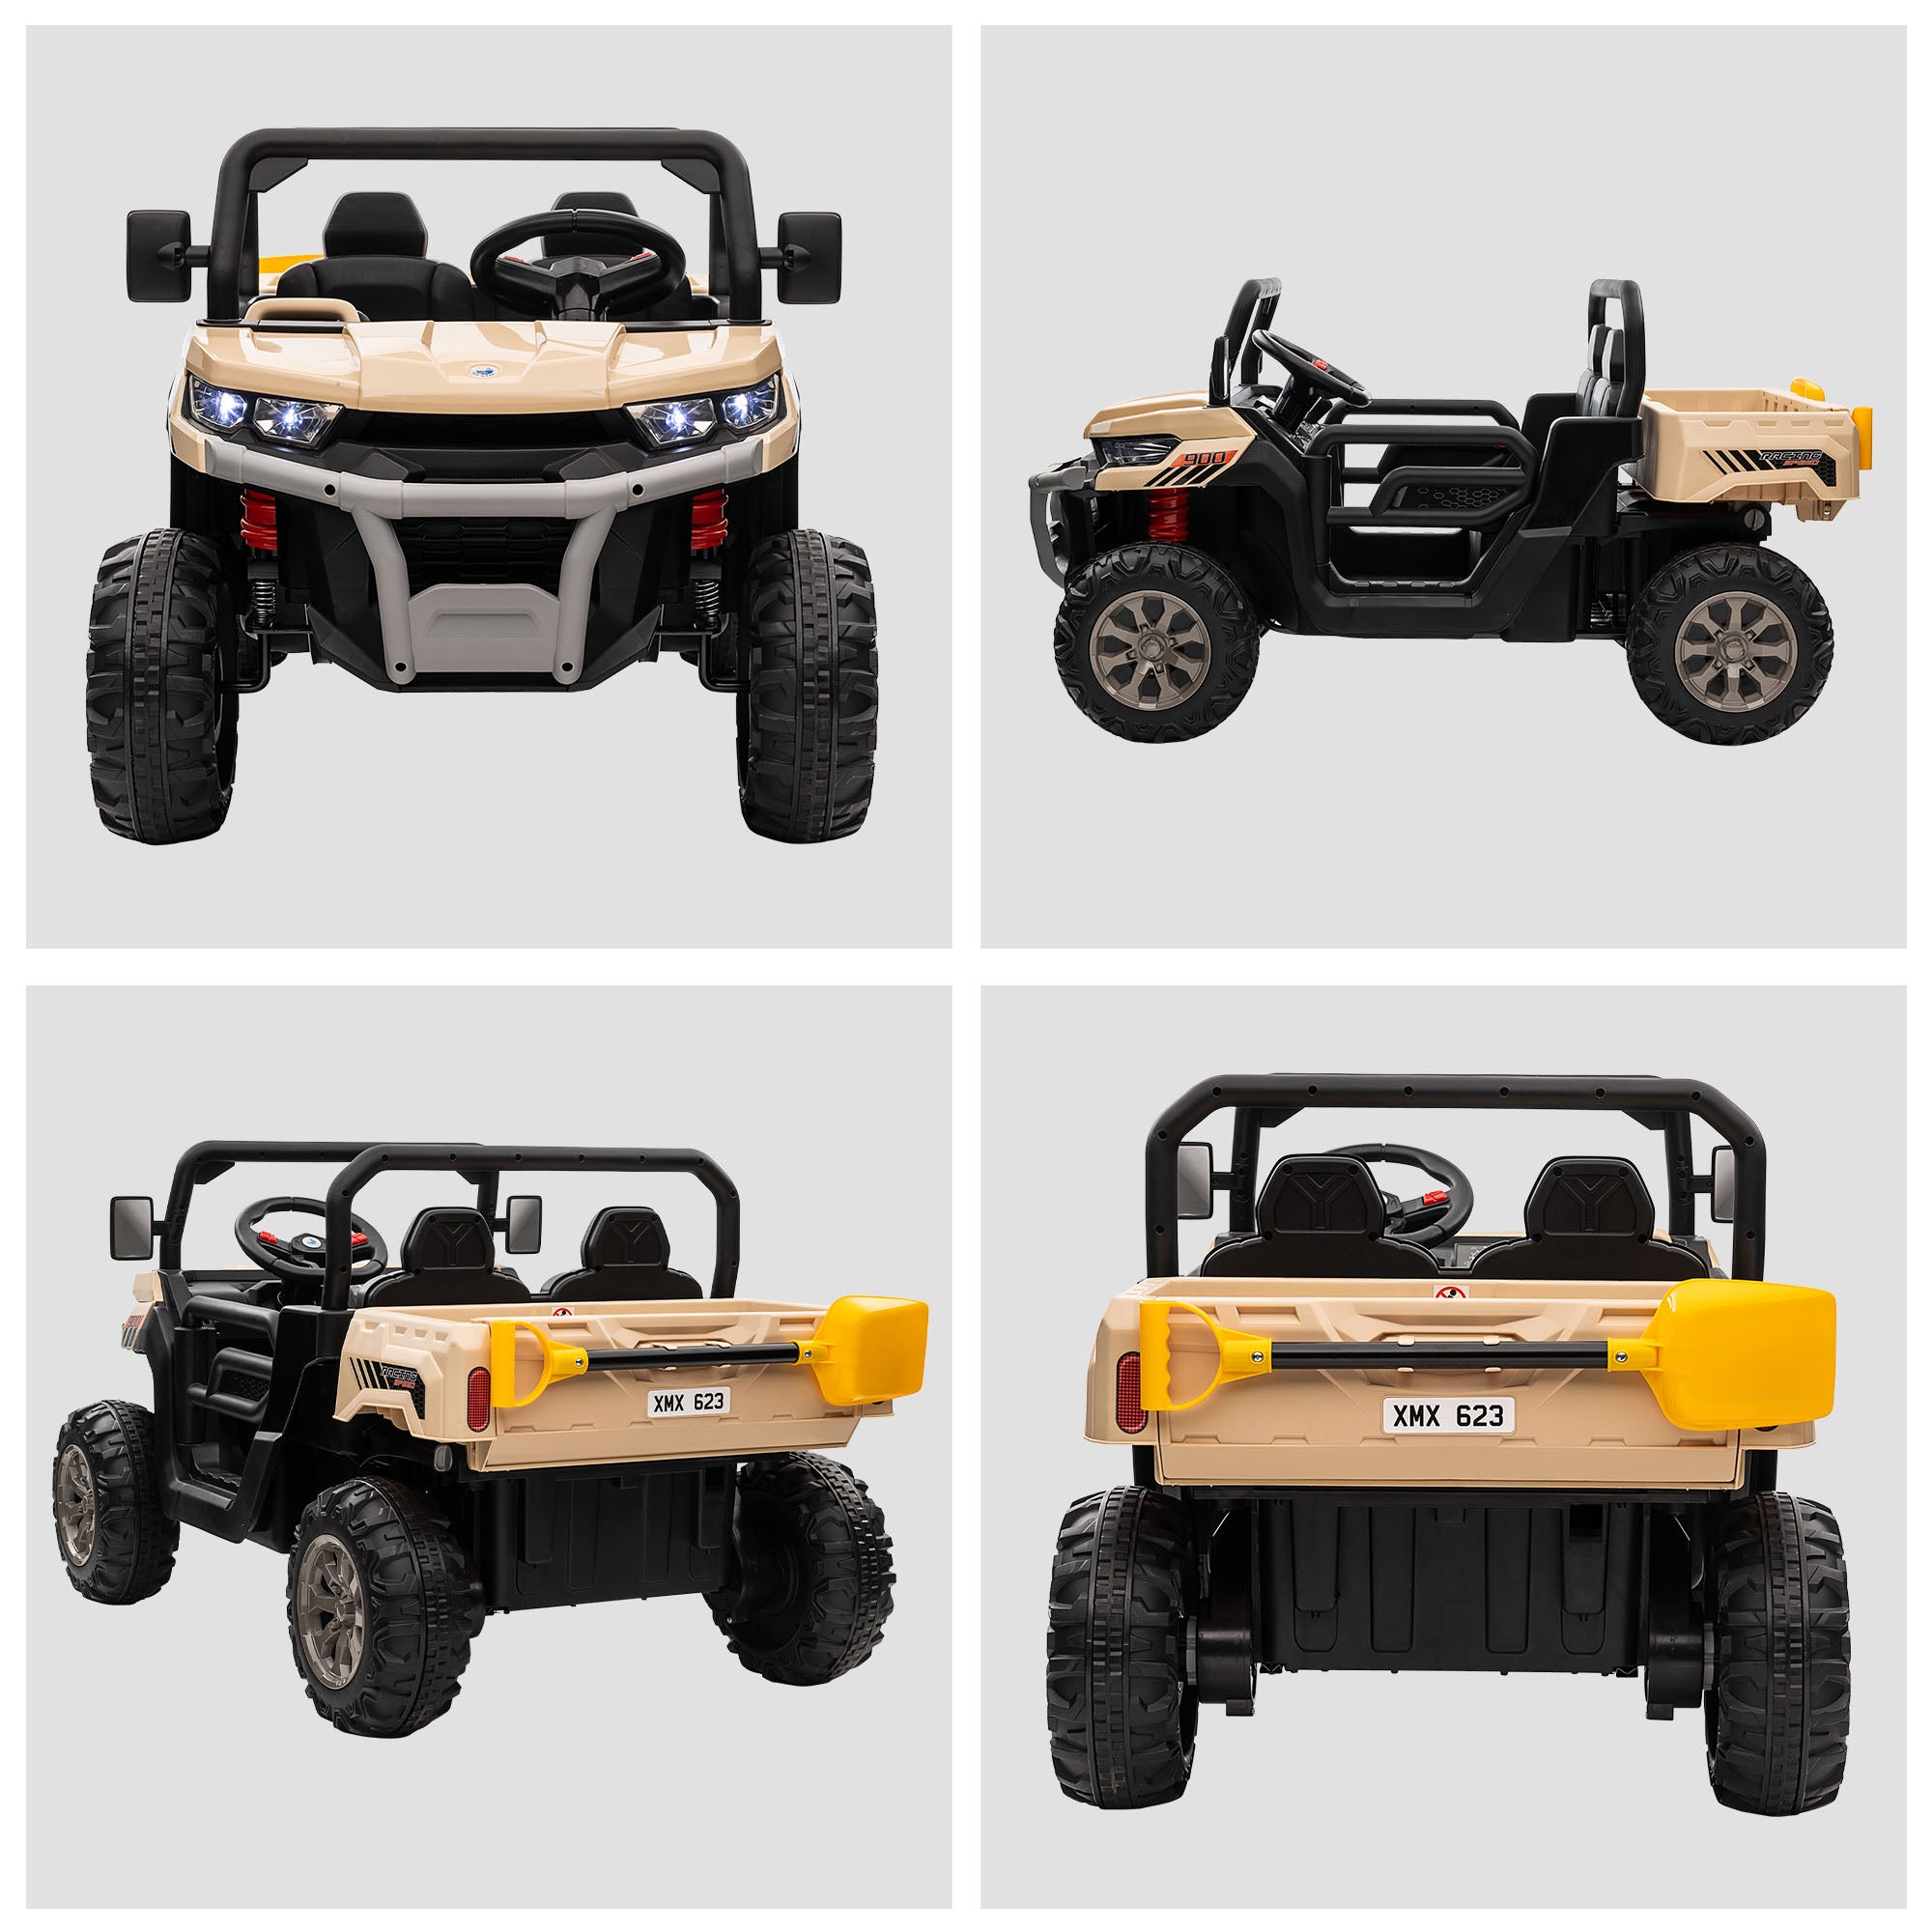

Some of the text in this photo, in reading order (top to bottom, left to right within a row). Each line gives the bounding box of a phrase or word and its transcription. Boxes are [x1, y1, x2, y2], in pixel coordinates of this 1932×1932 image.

[1182, 451, 1226, 467] 900
[1759, 451, 1823, 460] RACING
[381, 1366, 417, 1381] RACING
[654, 1392, 724, 1412] XMX 623
[1393, 1405, 1503, 1427] XMX 623
